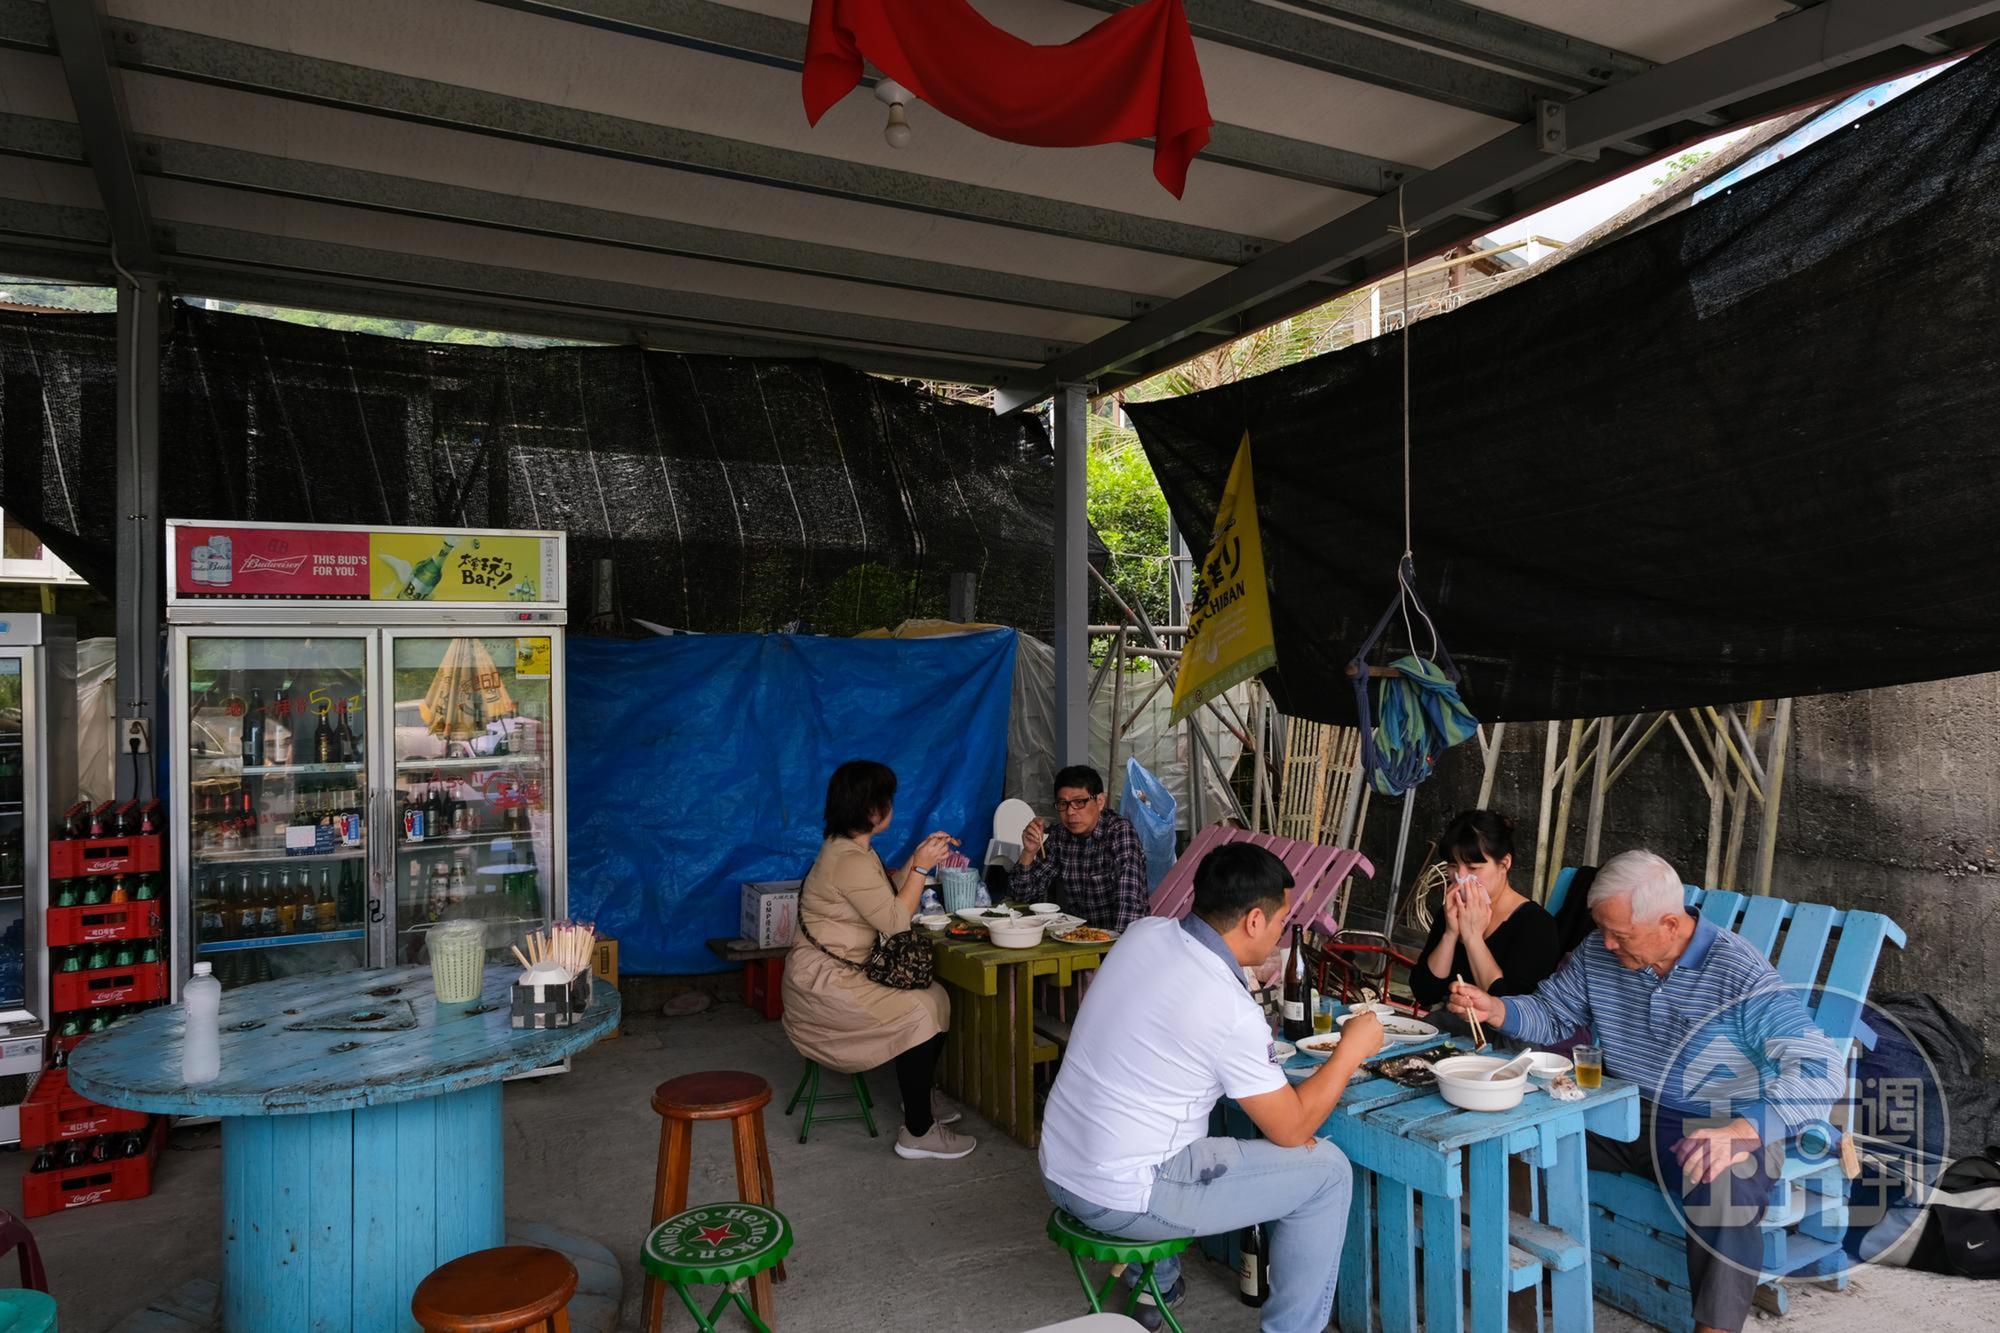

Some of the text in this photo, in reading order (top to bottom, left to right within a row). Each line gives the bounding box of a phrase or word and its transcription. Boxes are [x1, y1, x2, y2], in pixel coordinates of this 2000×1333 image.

[246, 557, 301, 571] Budweiser
[313, 555, 368, 566] THIS BUD'S
[313, 566, 358, 577] FOR YOU.
[658, 1211, 709, 1258] ORIGINAL
[699, 1207, 770, 1259] Heineken
